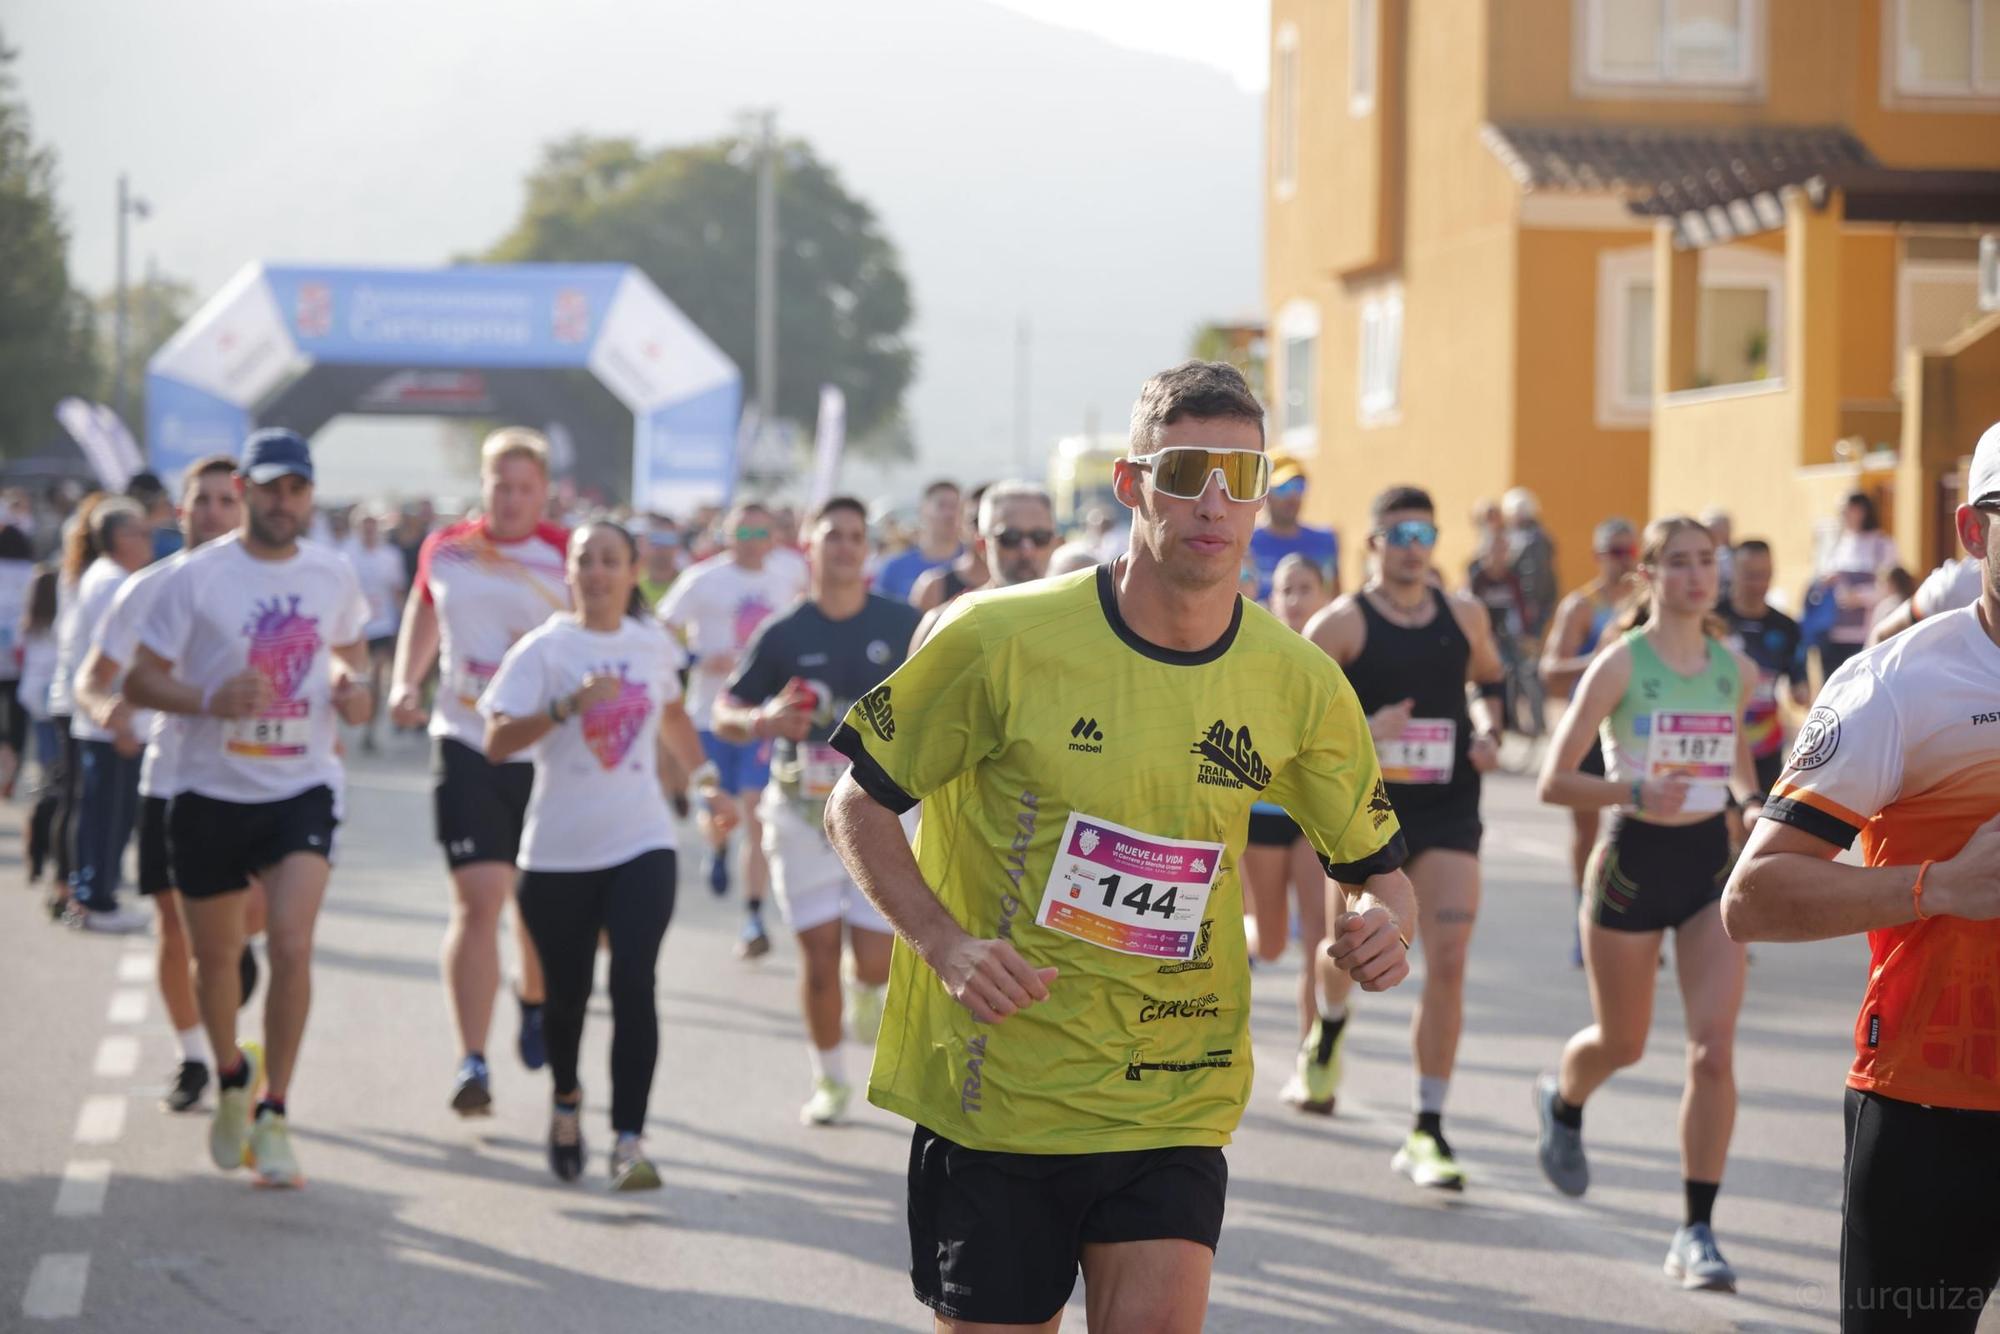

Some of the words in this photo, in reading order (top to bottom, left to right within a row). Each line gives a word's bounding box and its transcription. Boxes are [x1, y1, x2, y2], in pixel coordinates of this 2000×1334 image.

[1068, 742, 1102, 754] mobel
[1204, 719, 1272, 786] ALGAR
[1677, 738, 1721, 759] 187
[1197, 774, 1244, 790] RUNNING
[1199, 764, 1229, 778] TRAIL
[1115, 842, 1151, 860] MUEVE
[1151, 852, 1164, 863] LA
[1165, 854, 1184, 865] VIDA
[1098, 874, 1178, 919] 144
[961, 1033, 988, 1115] TRAIL
[1004, 790, 1041, 891] ALGAR
